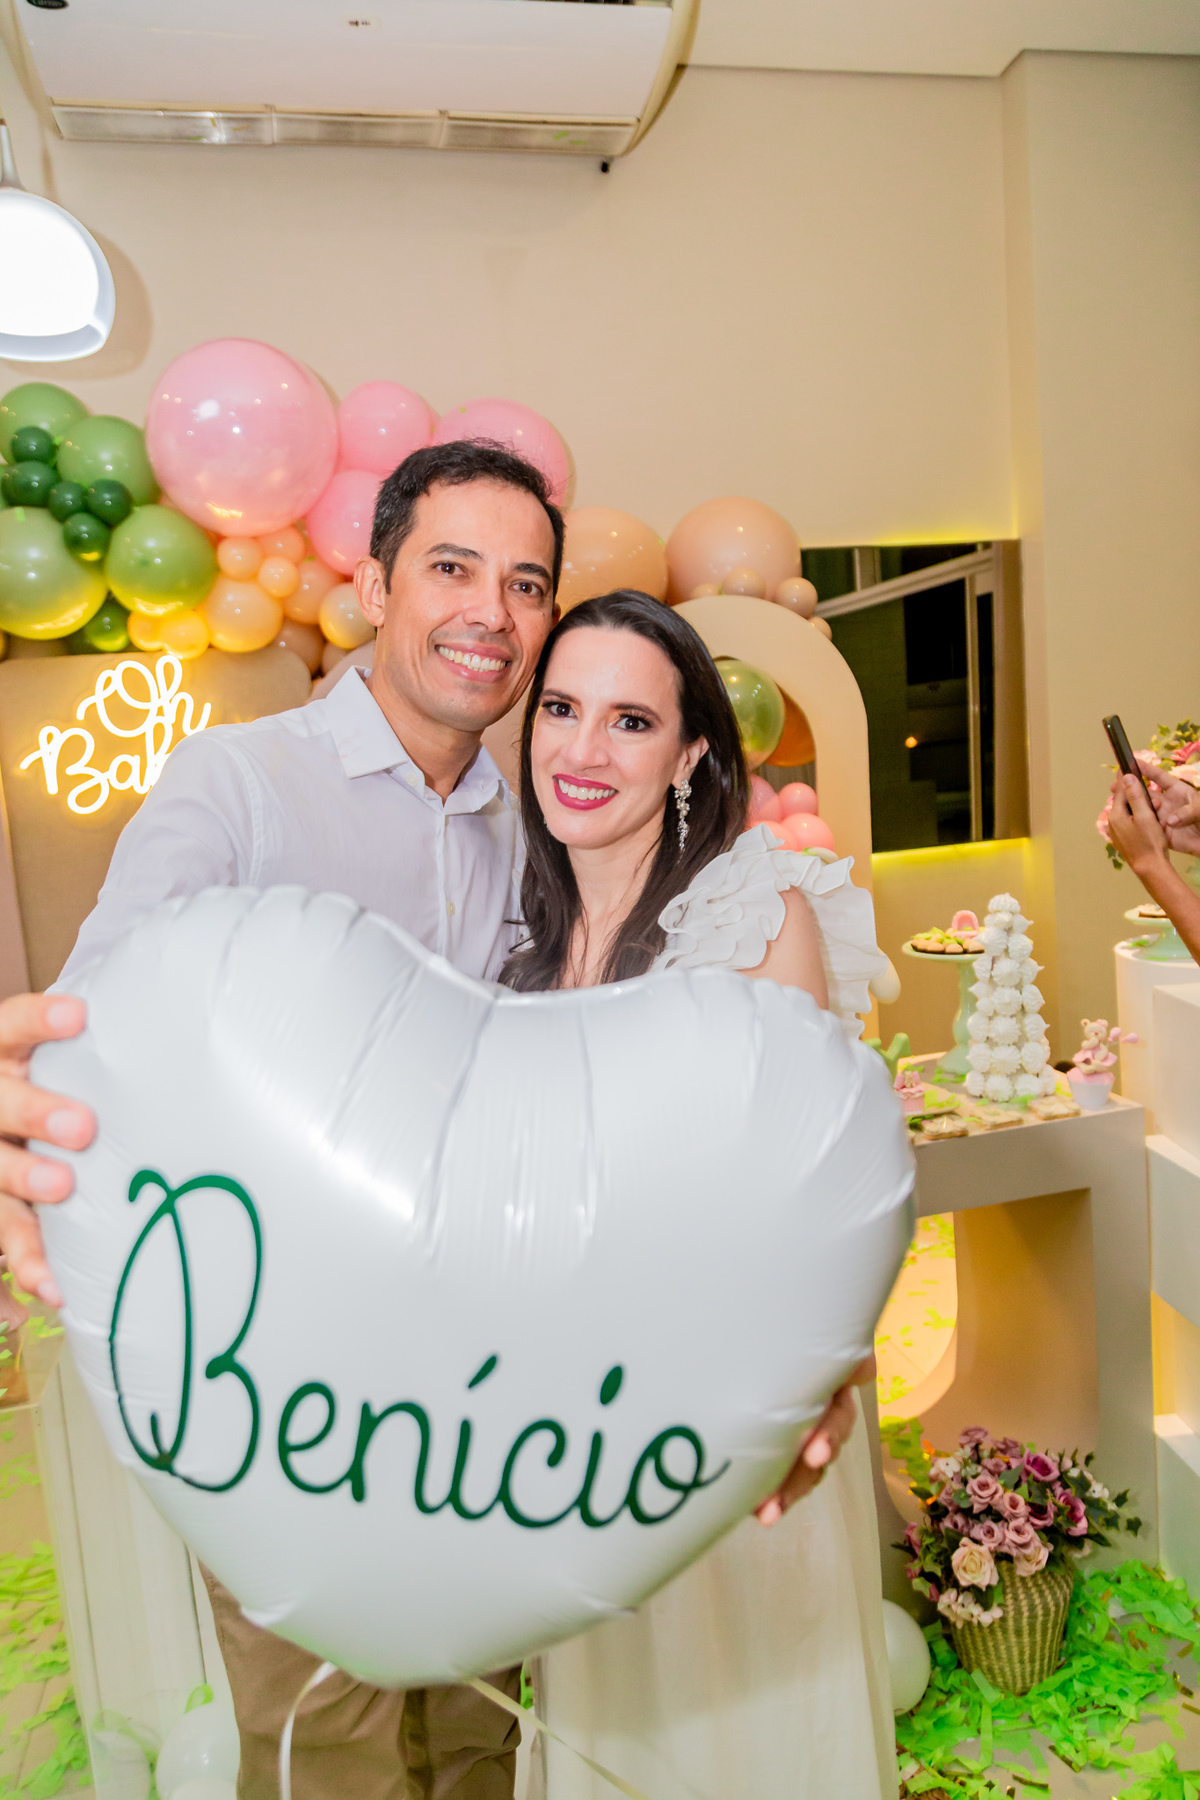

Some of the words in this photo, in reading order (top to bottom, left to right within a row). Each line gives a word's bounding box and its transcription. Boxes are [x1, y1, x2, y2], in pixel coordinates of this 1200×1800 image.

[76, 655, 211, 737] Oh
[19, 715, 173, 815] Bab
[108, 1169, 731, 1528] Benício
